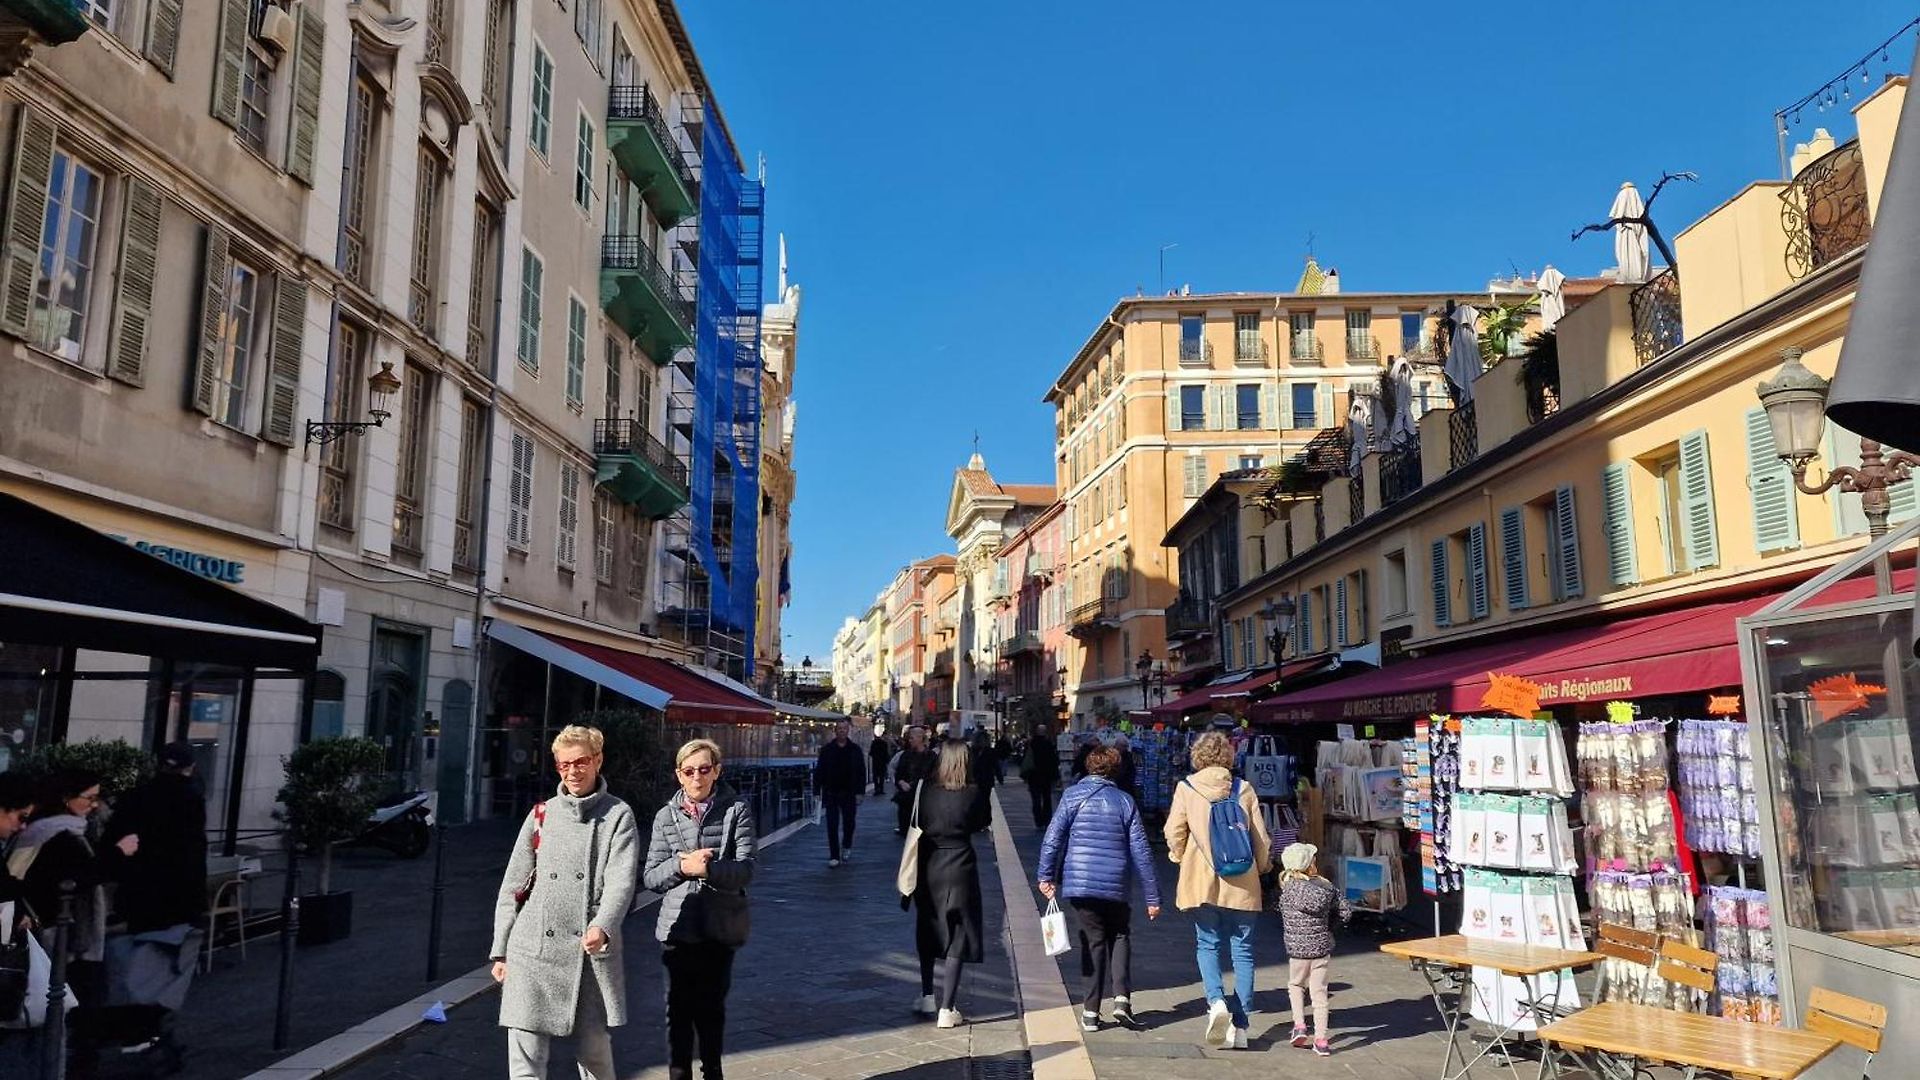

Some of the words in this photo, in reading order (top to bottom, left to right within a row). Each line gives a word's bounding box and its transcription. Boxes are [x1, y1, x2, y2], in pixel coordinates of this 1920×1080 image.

[1538, 682, 1559, 700] uits
[1561, 676, 1632, 701] Régionaux
[1394, 692, 1438, 713] PROVENCE
